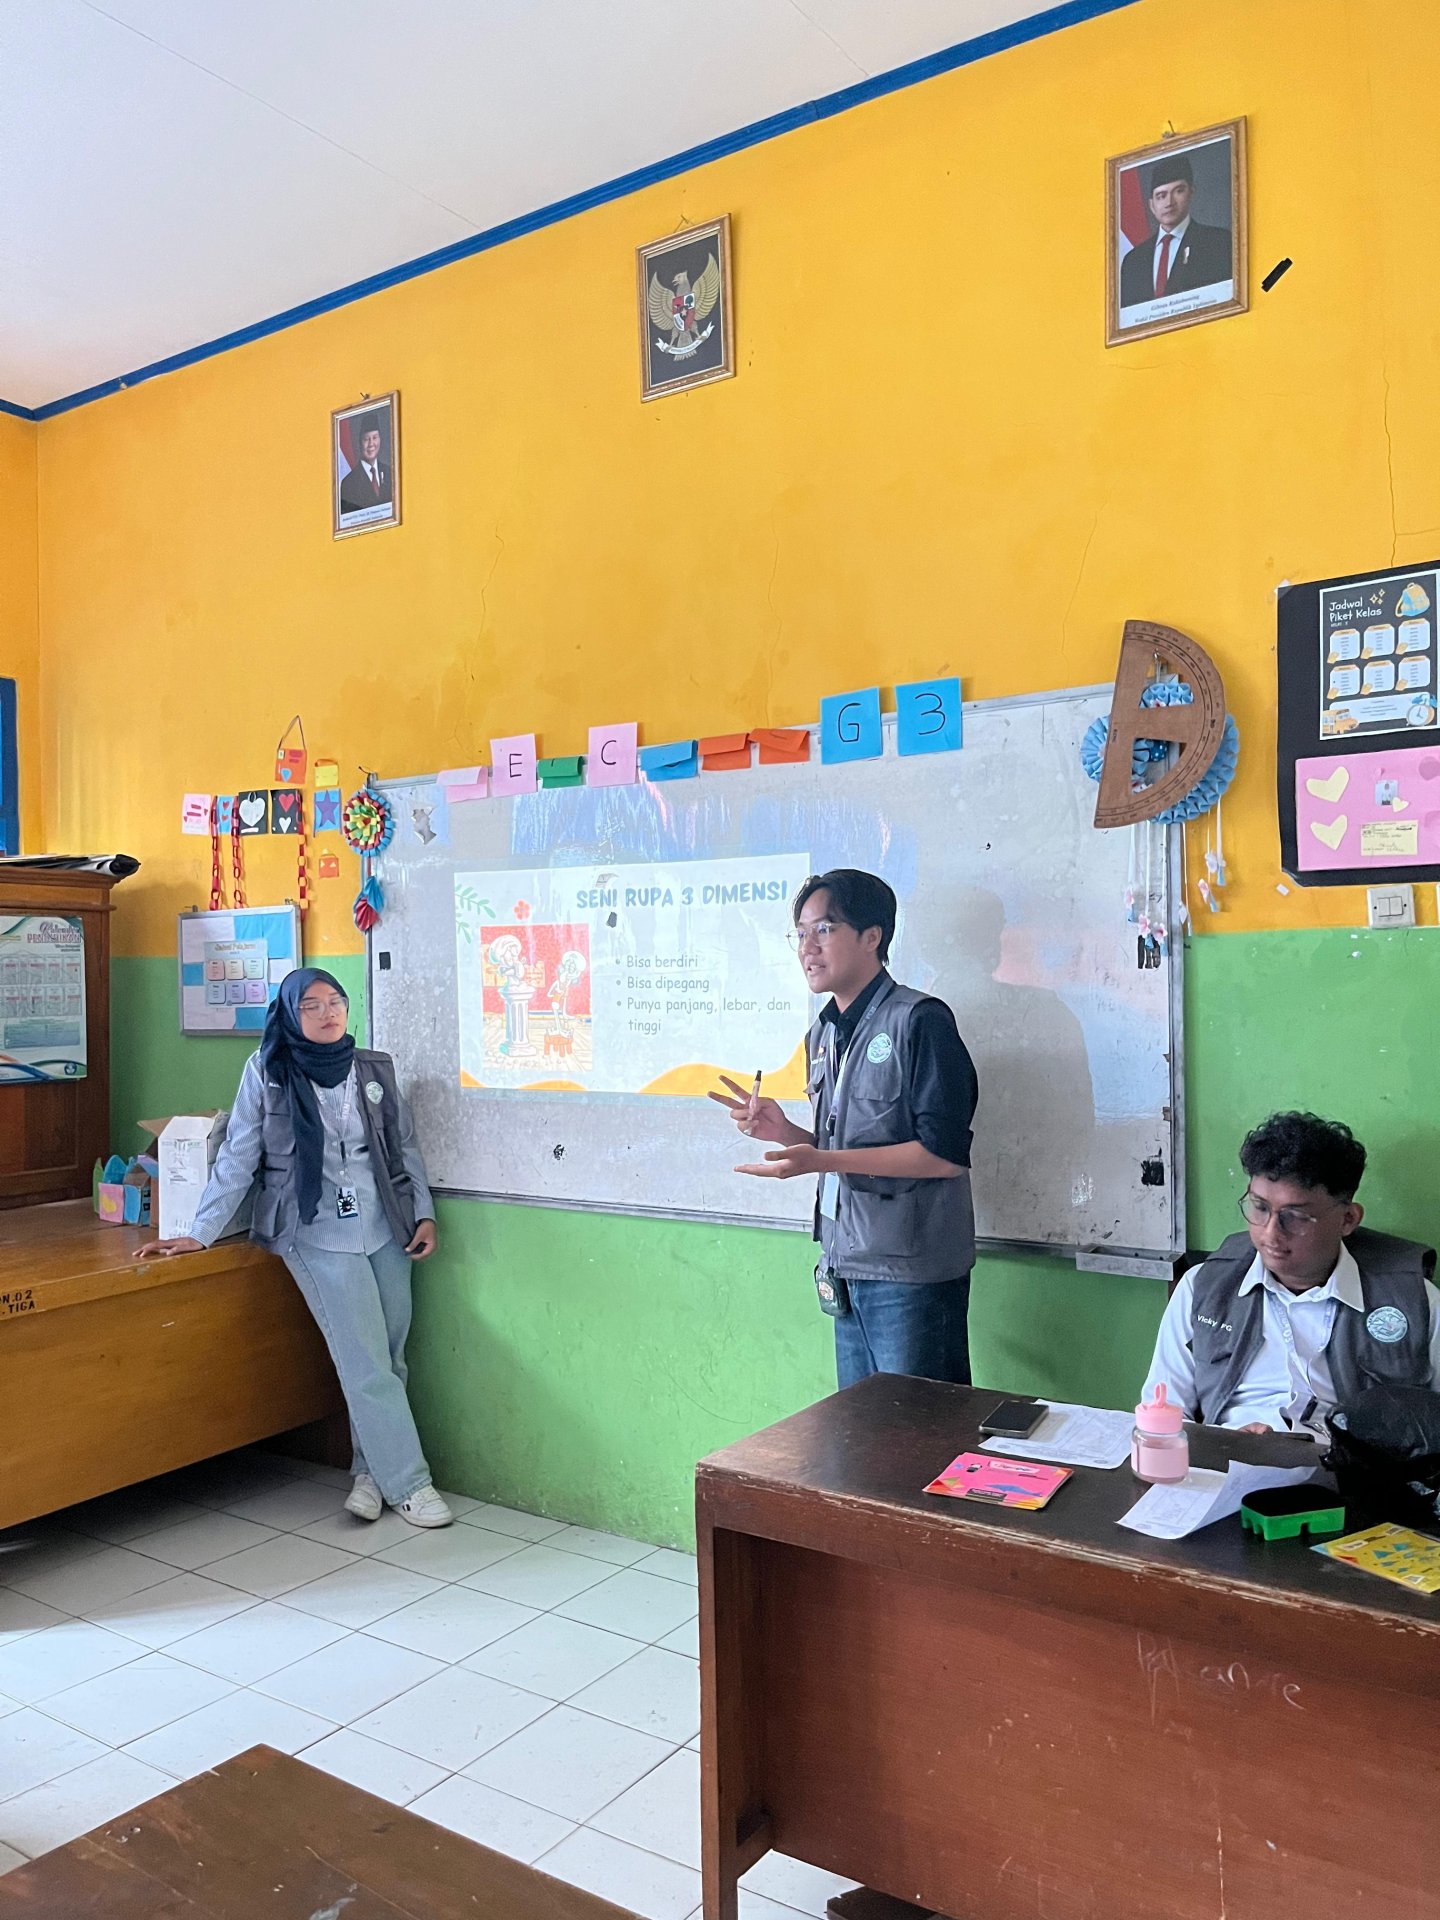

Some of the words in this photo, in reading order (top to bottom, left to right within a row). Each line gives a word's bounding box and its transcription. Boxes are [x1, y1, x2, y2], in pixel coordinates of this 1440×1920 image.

[1329, 597, 1363, 612] Jadwal
[1329, 609, 1353, 623] Piket
[1355, 607, 1382, 620] Kelas
[837, 702, 861, 743] G
[914, 692, 946, 736] 3
[600, 739, 617, 766] C
[508, 753, 523, 778] E
[576, 888, 618, 909] SENI
[625, 887, 674, 907] RUPA
[681, 886, 694, 905] 3
[702, 880, 788, 905] DIMENSI
[626, 954, 651, 968] Bisa
[655, 954, 698, 968] berdiri
[627, 976, 652, 989] Bisa
[655, 975, 710, 993] dipegang
[627, 997, 661, 1014] Punya
[666, 998, 717, 1015] panjang,
[723, 996, 761, 1013] lebar,
[767, 996, 791, 1011] dan
[628, 1018, 661, 1036] tinggi
[0, 1289, 33, 1304] N.02
[1197, 1314, 1218, 1327] Vicky
